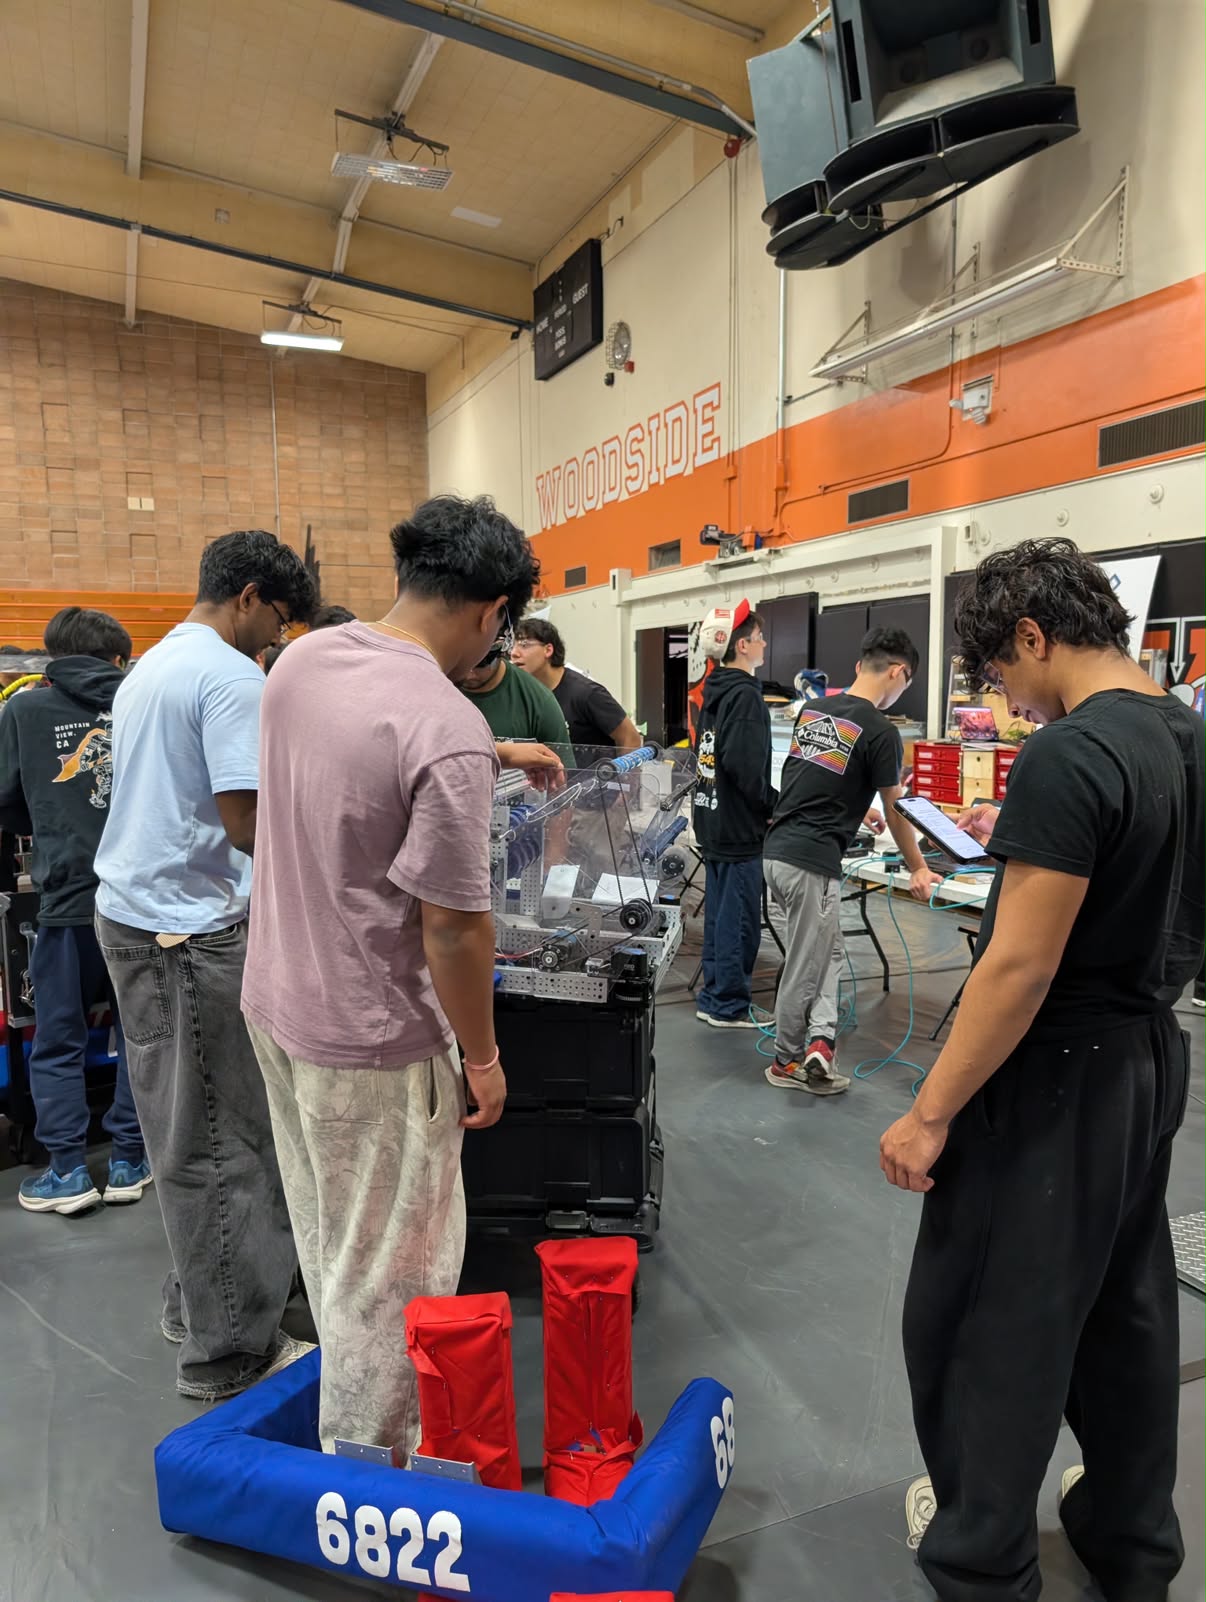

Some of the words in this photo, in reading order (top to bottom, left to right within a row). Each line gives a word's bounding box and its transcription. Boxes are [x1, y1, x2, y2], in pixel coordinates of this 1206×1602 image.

[572, 283, 588, 304] GUEST
[536, 316, 549, 334] HOME
[536, 381, 721, 530] WOODSIDE
[54, 722, 90, 732] MOUNTAIN
[56, 740, 69, 749] CA
[804, 731, 838, 748] Columbia
[315, 1491, 471, 1593] 6822
